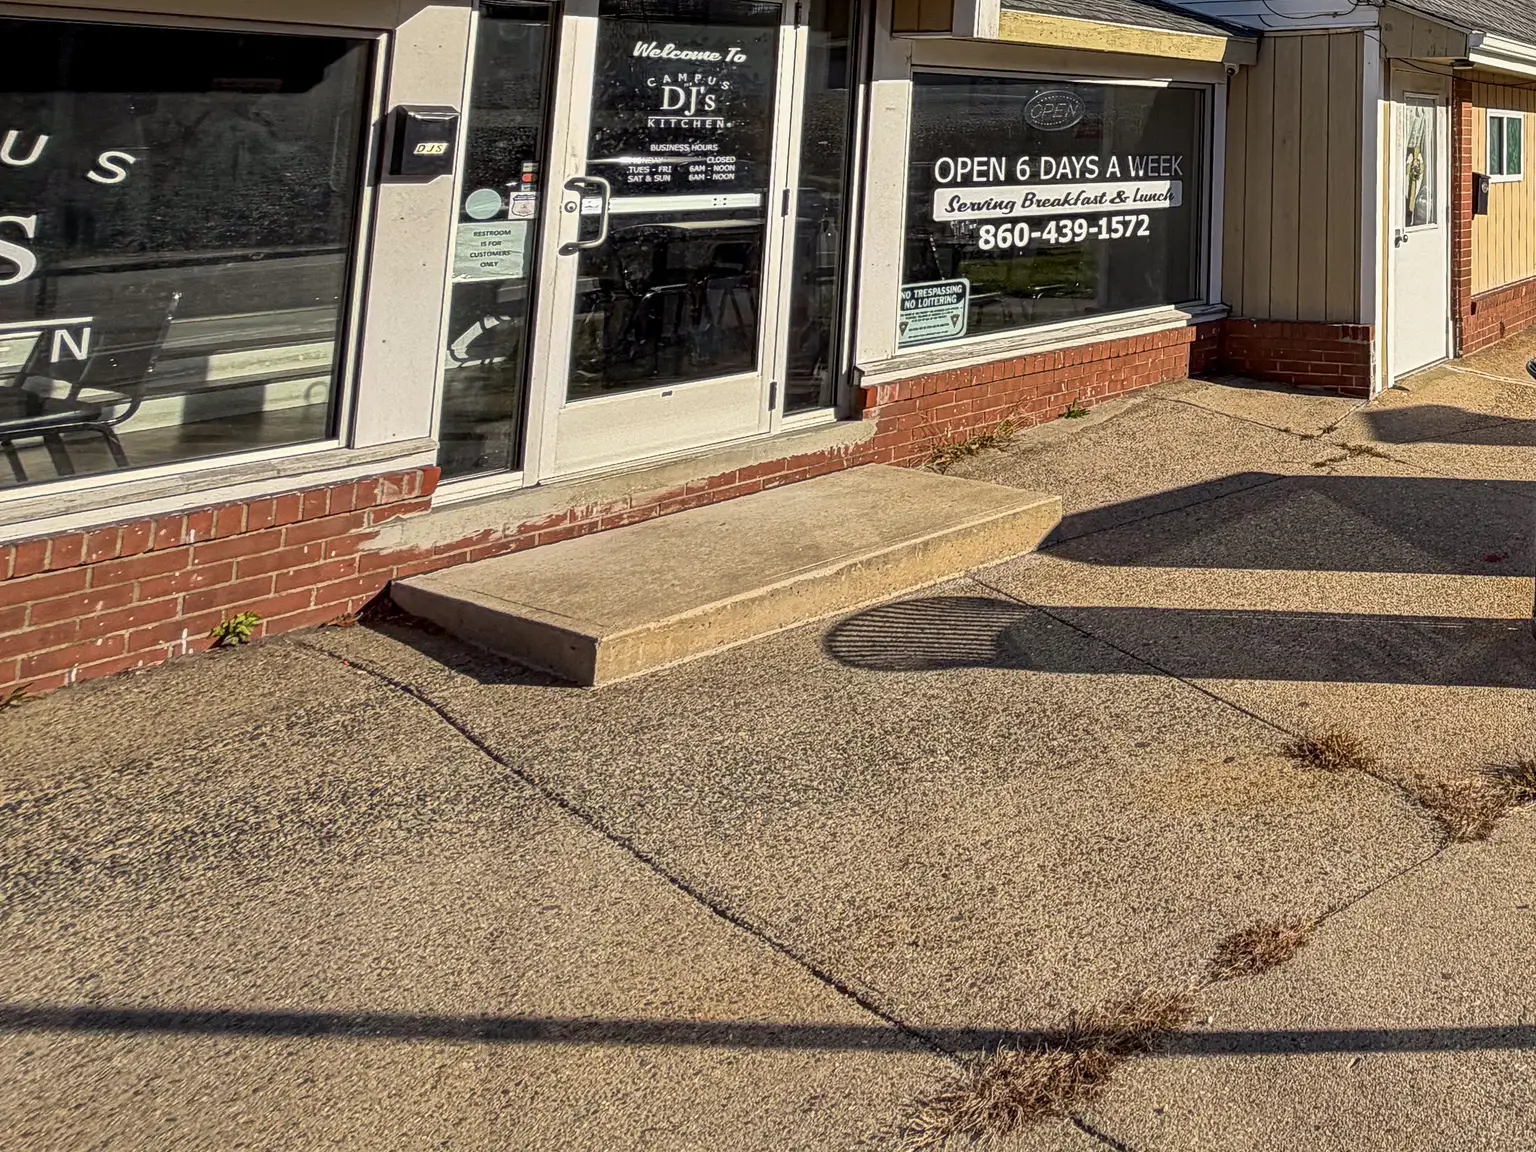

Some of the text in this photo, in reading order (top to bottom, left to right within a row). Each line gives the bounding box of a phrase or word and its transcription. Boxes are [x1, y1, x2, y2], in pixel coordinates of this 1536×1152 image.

[633, 41, 747, 63] Welcome To
[647, 73, 730, 90] CAMPUS
[660, 85, 716, 117] DJ's
[1030, 103, 1080, 123] OPEN
[647, 118, 725, 129] KITCHEN
[416, 144, 444, 153] DJS
[650, 144, 690, 152] BUSINESS
[706, 155, 736, 164] CLOSED
[628, 165, 650, 174] TUES
[658, 165, 672, 173] FRI
[689, 164, 706, 173] 6AM
[713, 164, 736, 172] NOON
[934, 155, 1183, 184] OPEN 6 DAYS A WEEK
[627, 175, 644, 183] SAT
[645, 174, 653, 183] &
[654, 174, 671, 182] SUN
[688, 173, 705, 182] 6AM
[712, 172, 735, 181] NOON
[944, 187, 1175, 215] Serving Breakfast & Lunch
[473, 229, 512, 237] RESTROOM
[978, 214, 1151, 251] 860-439-1572
[469, 250, 511, 258] CUSTOMERS
[900, 284, 963, 300] NO TRESPASSING
[904, 294, 957, 310] NO LOITERING
